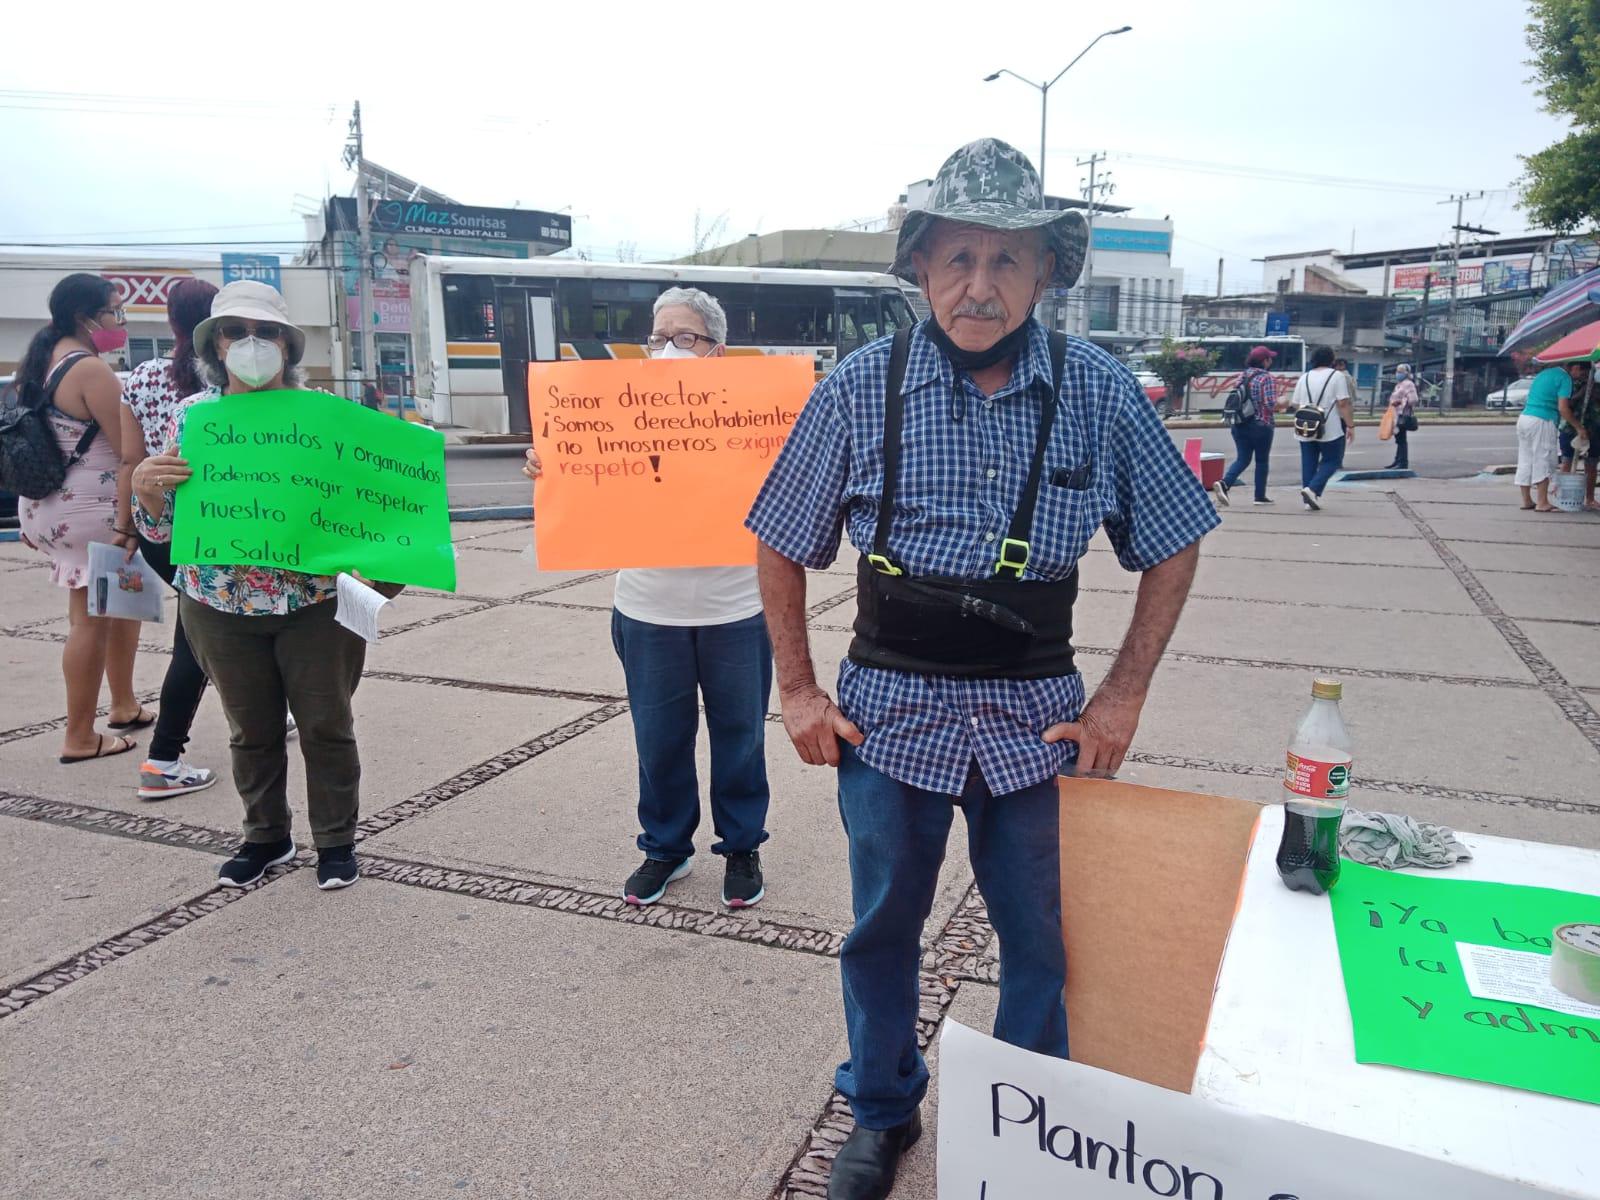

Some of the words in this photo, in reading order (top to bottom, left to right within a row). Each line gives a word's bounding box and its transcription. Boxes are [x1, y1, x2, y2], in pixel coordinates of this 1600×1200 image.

[404, 204, 449, 225] Maz
[451, 213, 507, 230] Sonrisas
[453, 228, 508, 239] DENTALES
[228, 258, 276, 281] spin
[548, 385, 604, 410] Señor
[618, 380, 728, 408] director:
[203, 422, 247, 446] Solo
[253, 423, 322, 449] unidos
[354, 446, 441, 484] organizados
[556, 440, 583, 455] no
[596, 435, 717, 455] limosneros
[559, 455, 662, 487] respeto!
[202, 463, 281, 484] Podemos
[290, 472, 345, 499] exigir
[355, 486, 429, 515] respetar
[200, 498, 286, 523] nuestro
[310, 507, 386, 543] derecho
[396, 534, 412, 547] a
[194, 536, 217, 559] la
[230, 538, 301, 567] Salud
[1398, 946, 1448, 974] la
[991, 1081, 1224, 1200] Planton
